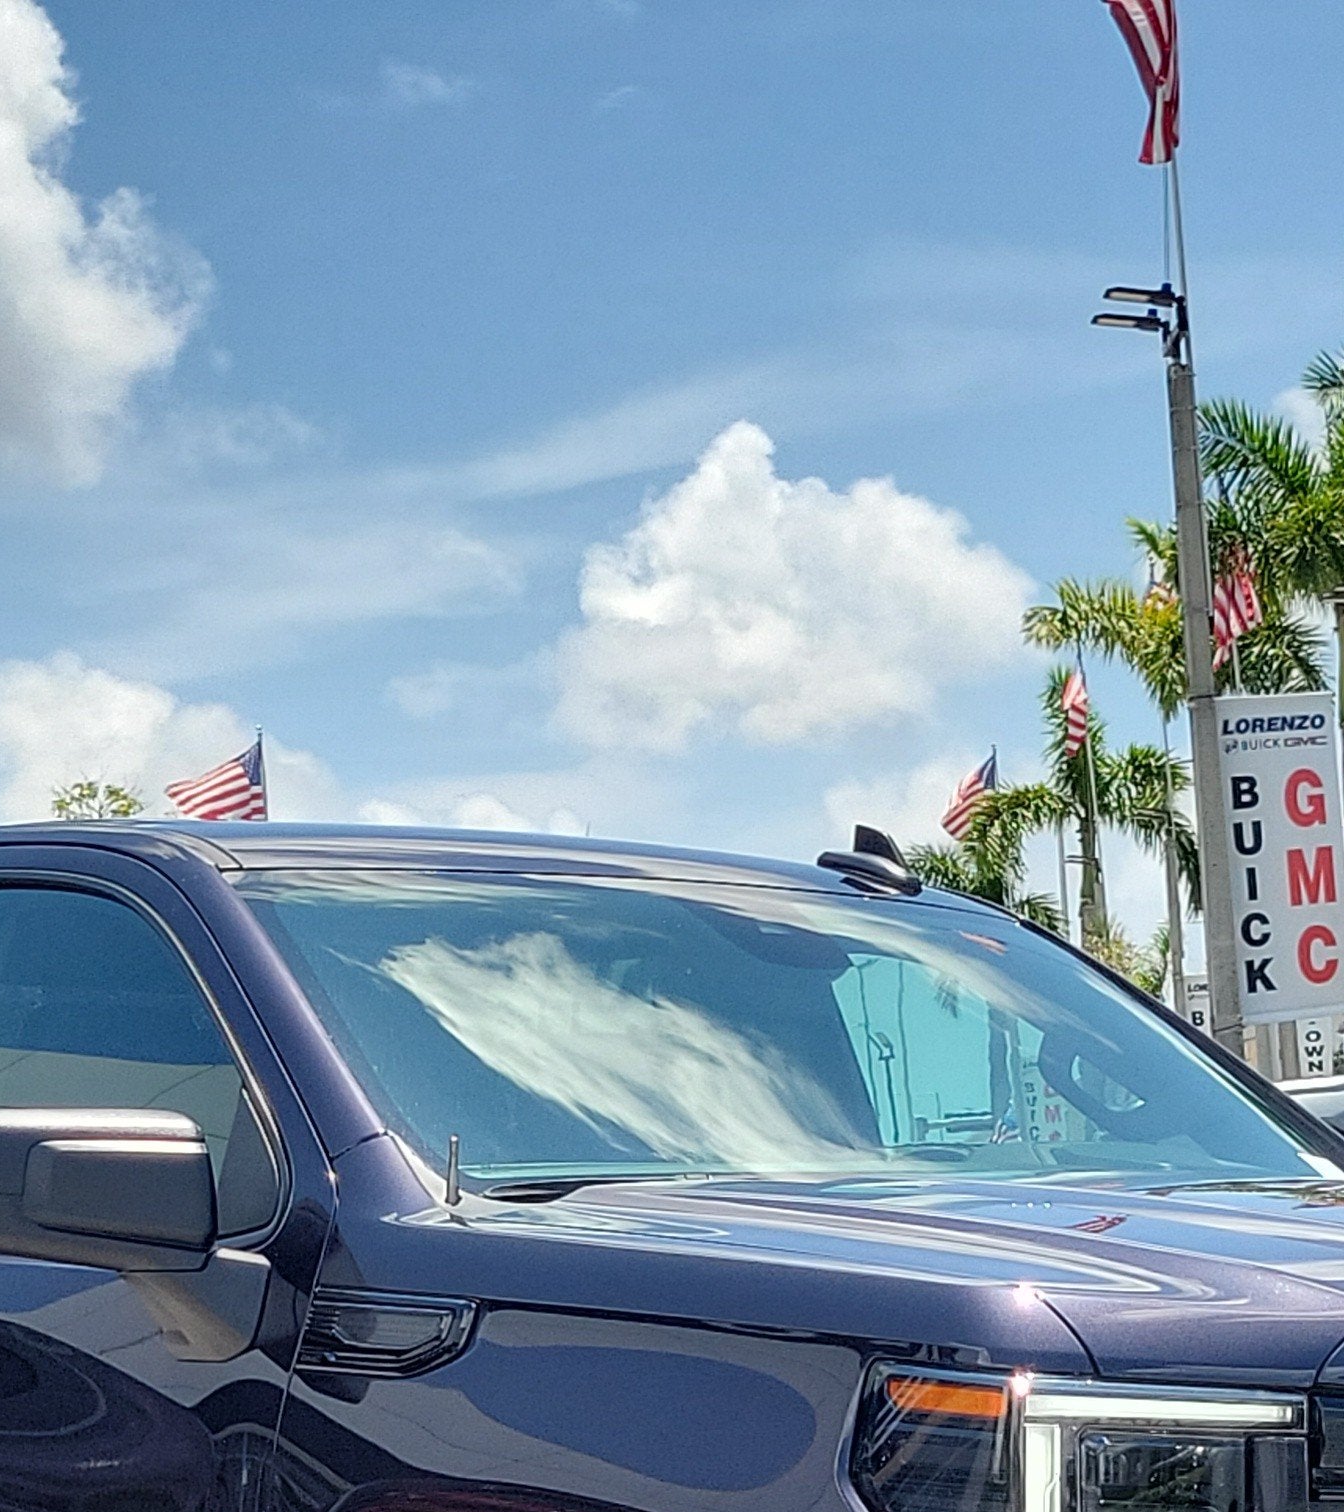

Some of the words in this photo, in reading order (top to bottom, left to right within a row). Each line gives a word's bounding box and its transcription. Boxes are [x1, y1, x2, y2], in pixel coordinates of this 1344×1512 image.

[1221, 714, 1325, 735] LORENZO
[1241, 738, 1280, 751] BUICK
[1284, 735, 1328, 747] GMC
[1231, 776, 1276, 994] BUICK
[1283, 768, 1339, 984] GMC
